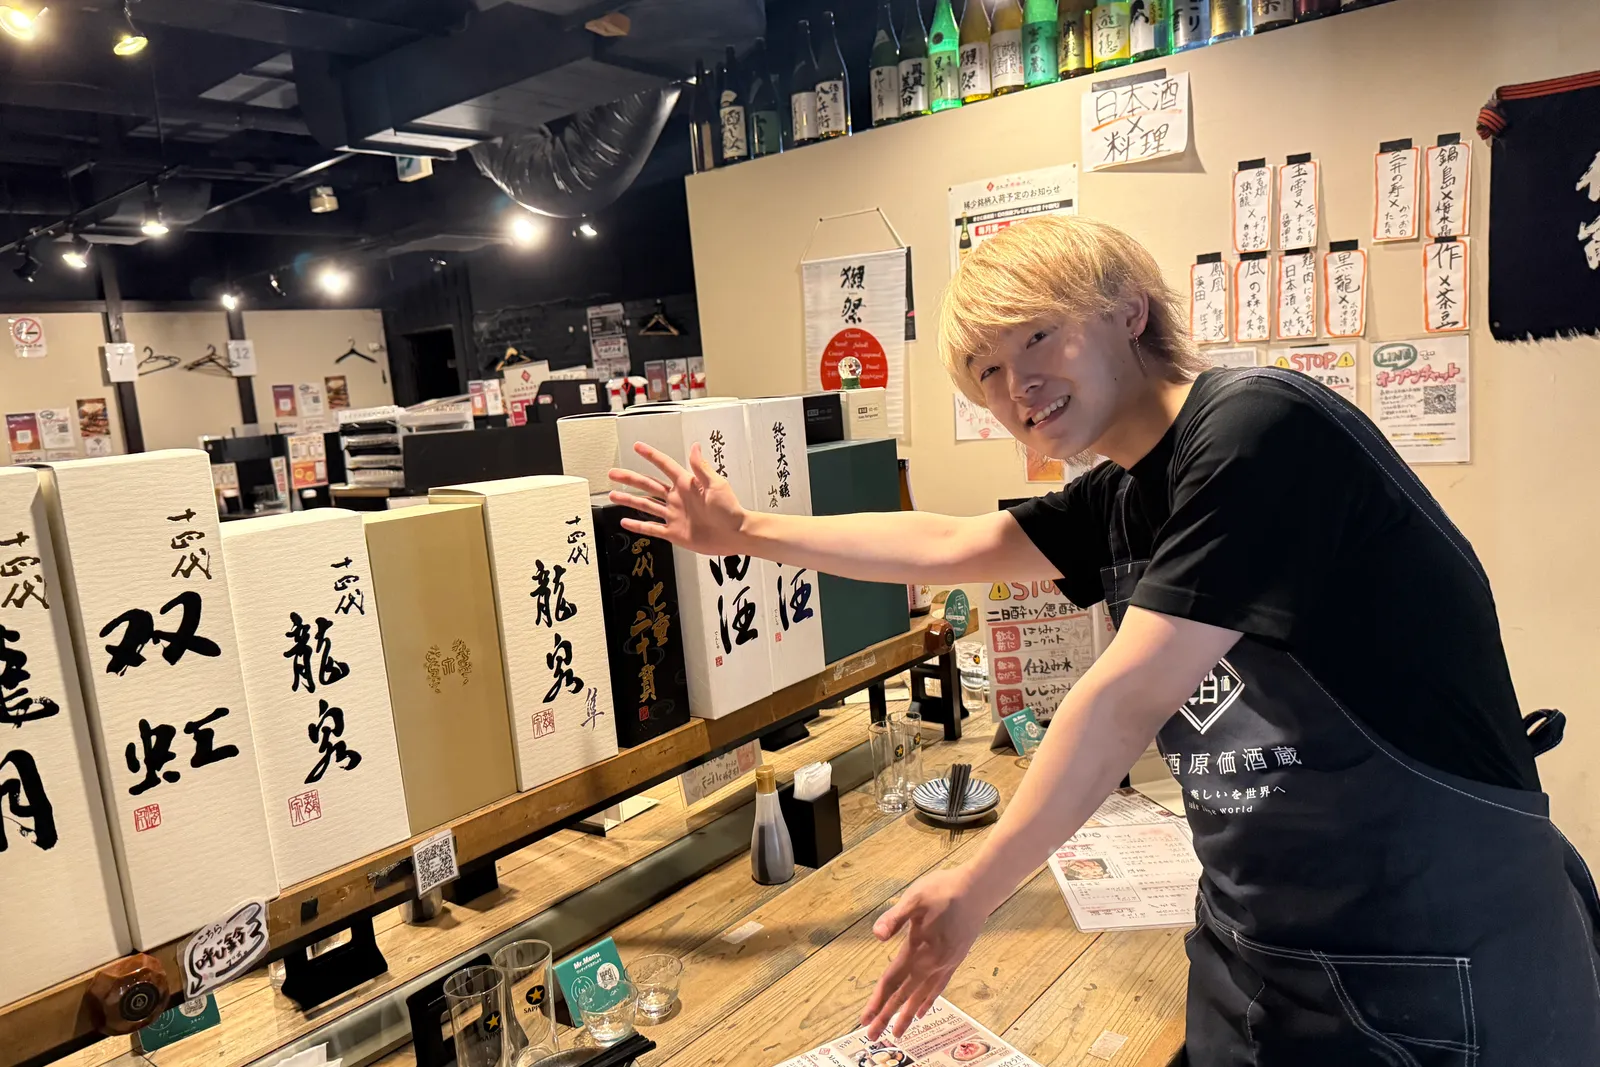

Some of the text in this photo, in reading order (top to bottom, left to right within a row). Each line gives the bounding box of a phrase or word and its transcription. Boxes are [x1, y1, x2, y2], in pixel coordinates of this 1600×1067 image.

[1094, 80, 1179, 126] 日本酒
[1103, 122, 1171, 163] 料理
[840, 264, 867, 325] 獺祭
[235, 347, 250, 360] 12
[1290, 351, 1337, 371] STOP
[1376, 362, 1461, 388] オープンチャット
[167, 507, 212, 580] 十四代
[565, 515, 589, 565] 十四代
[330, 556, 366, 616] 十四代
[1022, 624, 1061, 637] はちみつ
[1024, 635, 1065, 648] ヨーグルト
[1024, 657, 1073, 676] 仕込み水
[99, 591, 240, 797] 双虹
[1219, 804, 1254, 814] world
[197, 923, 223, 944] こちら
[573, 951, 601, 970] Mr.Menu
